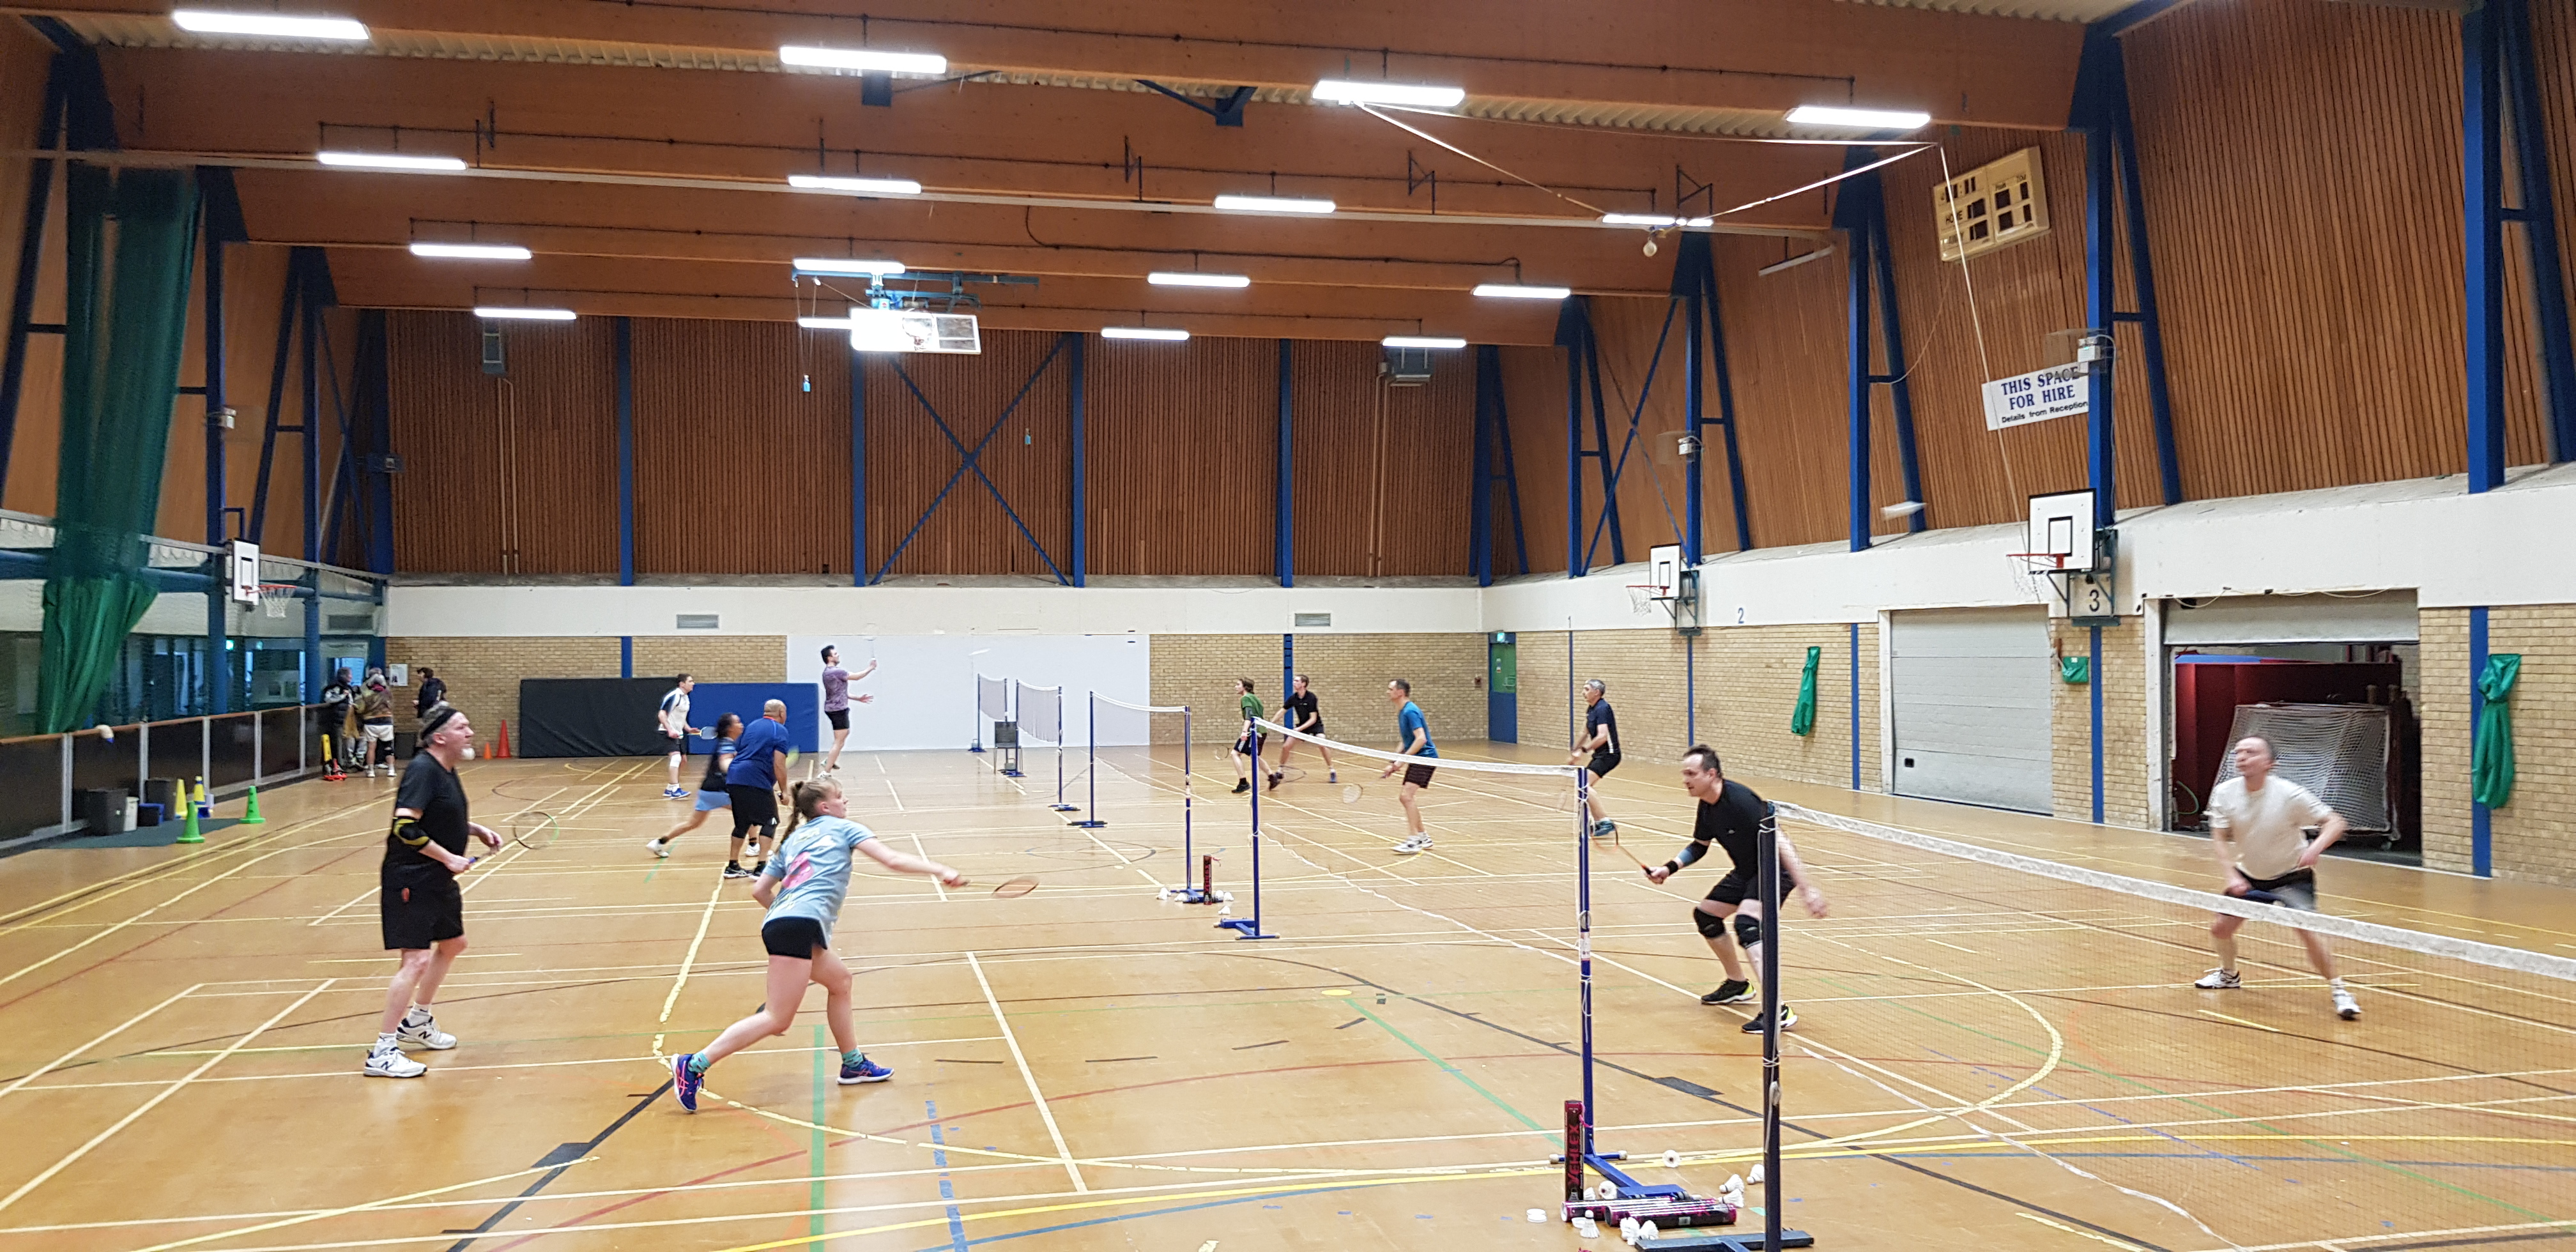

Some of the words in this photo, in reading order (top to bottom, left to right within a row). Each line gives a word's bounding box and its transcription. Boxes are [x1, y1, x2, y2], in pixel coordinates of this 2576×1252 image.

[1945, 210, 1963, 225] HOE
[2001, 378, 2032, 395] THIS
[2037, 366, 2080, 387] SPACE
[2009, 393, 2035, 410] FOR
[2042, 385, 2076, 403] HIRE
[2002, 413, 2025, 423] Details
[2029, 409, 2047, 418] from
[2050, 401, 2088, 413] Reception
[2089, 589, 2100, 612] 3
[1738, 607, 1744, 624] 2
